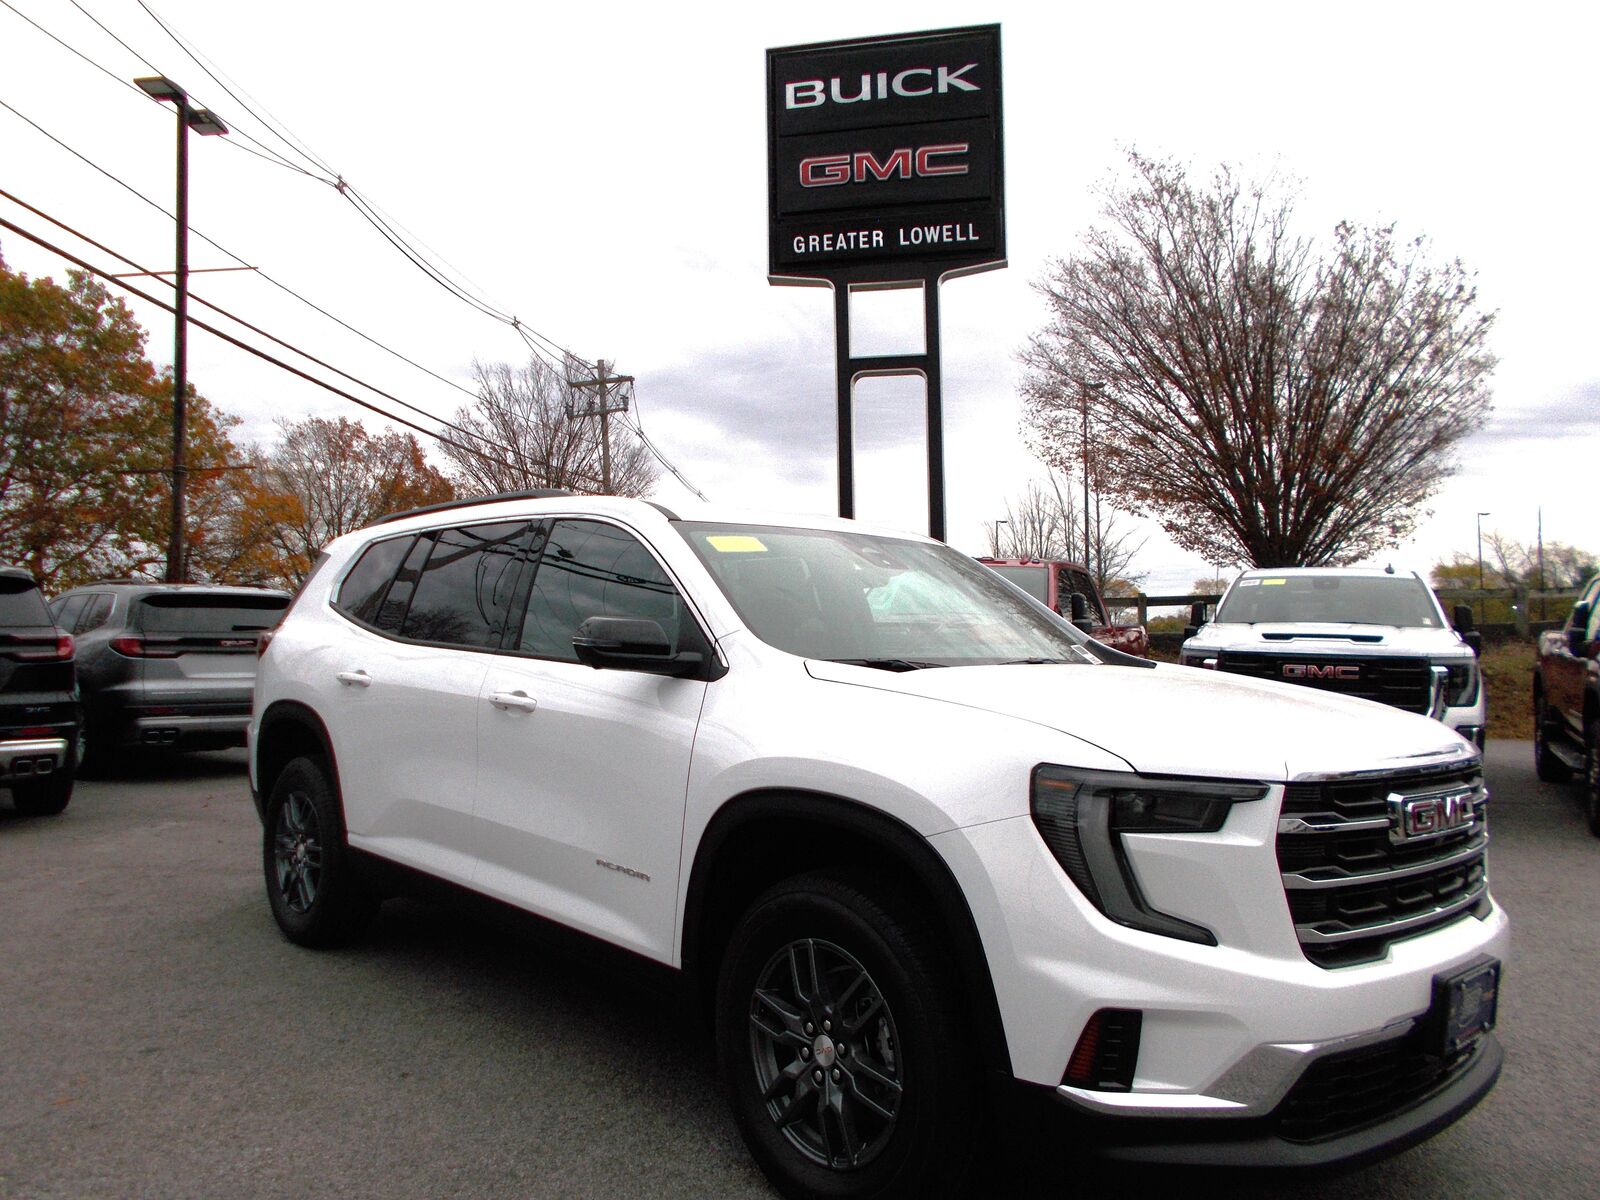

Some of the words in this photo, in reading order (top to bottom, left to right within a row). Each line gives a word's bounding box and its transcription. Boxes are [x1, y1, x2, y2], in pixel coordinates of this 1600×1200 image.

[785, 63, 981, 110] BUICK
[800, 142, 969, 188] GMC
[793, 230, 884, 253] GREATER
[899, 223, 979, 246] LOWELL
[1282, 664, 1360, 680] GMC
[1407, 793, 1475, 834] GMC
